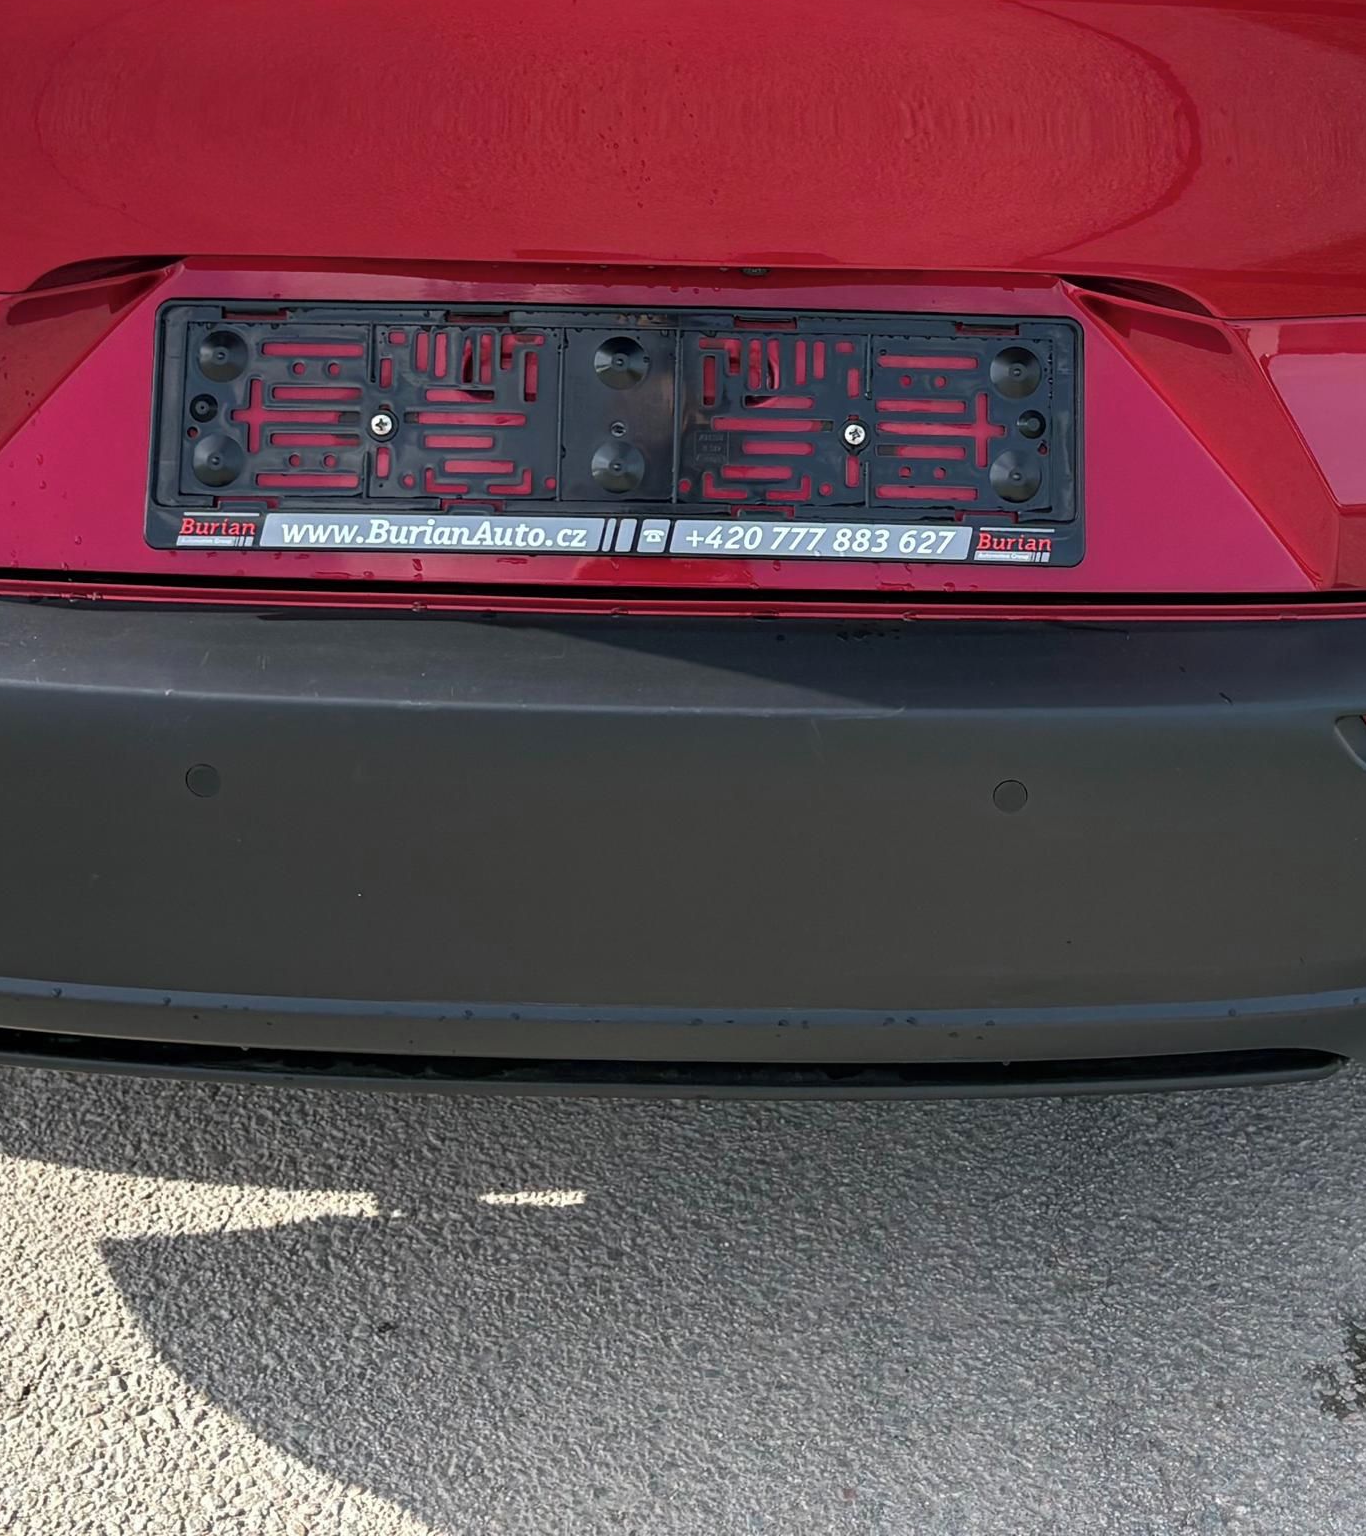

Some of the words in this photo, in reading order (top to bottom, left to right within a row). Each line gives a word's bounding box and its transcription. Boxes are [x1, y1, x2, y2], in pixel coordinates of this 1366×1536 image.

[178, 517, 256, 536] Burian
[281, 518, 588, 547] www.BurianAuto.cz
[685, 525, 763, 550] +420
[770, 526, 827, 551] 777
[832, 528, 890, 553] 883
[898, 530, 957, 554] 627
[976, 532, 1052, 552] Burian
